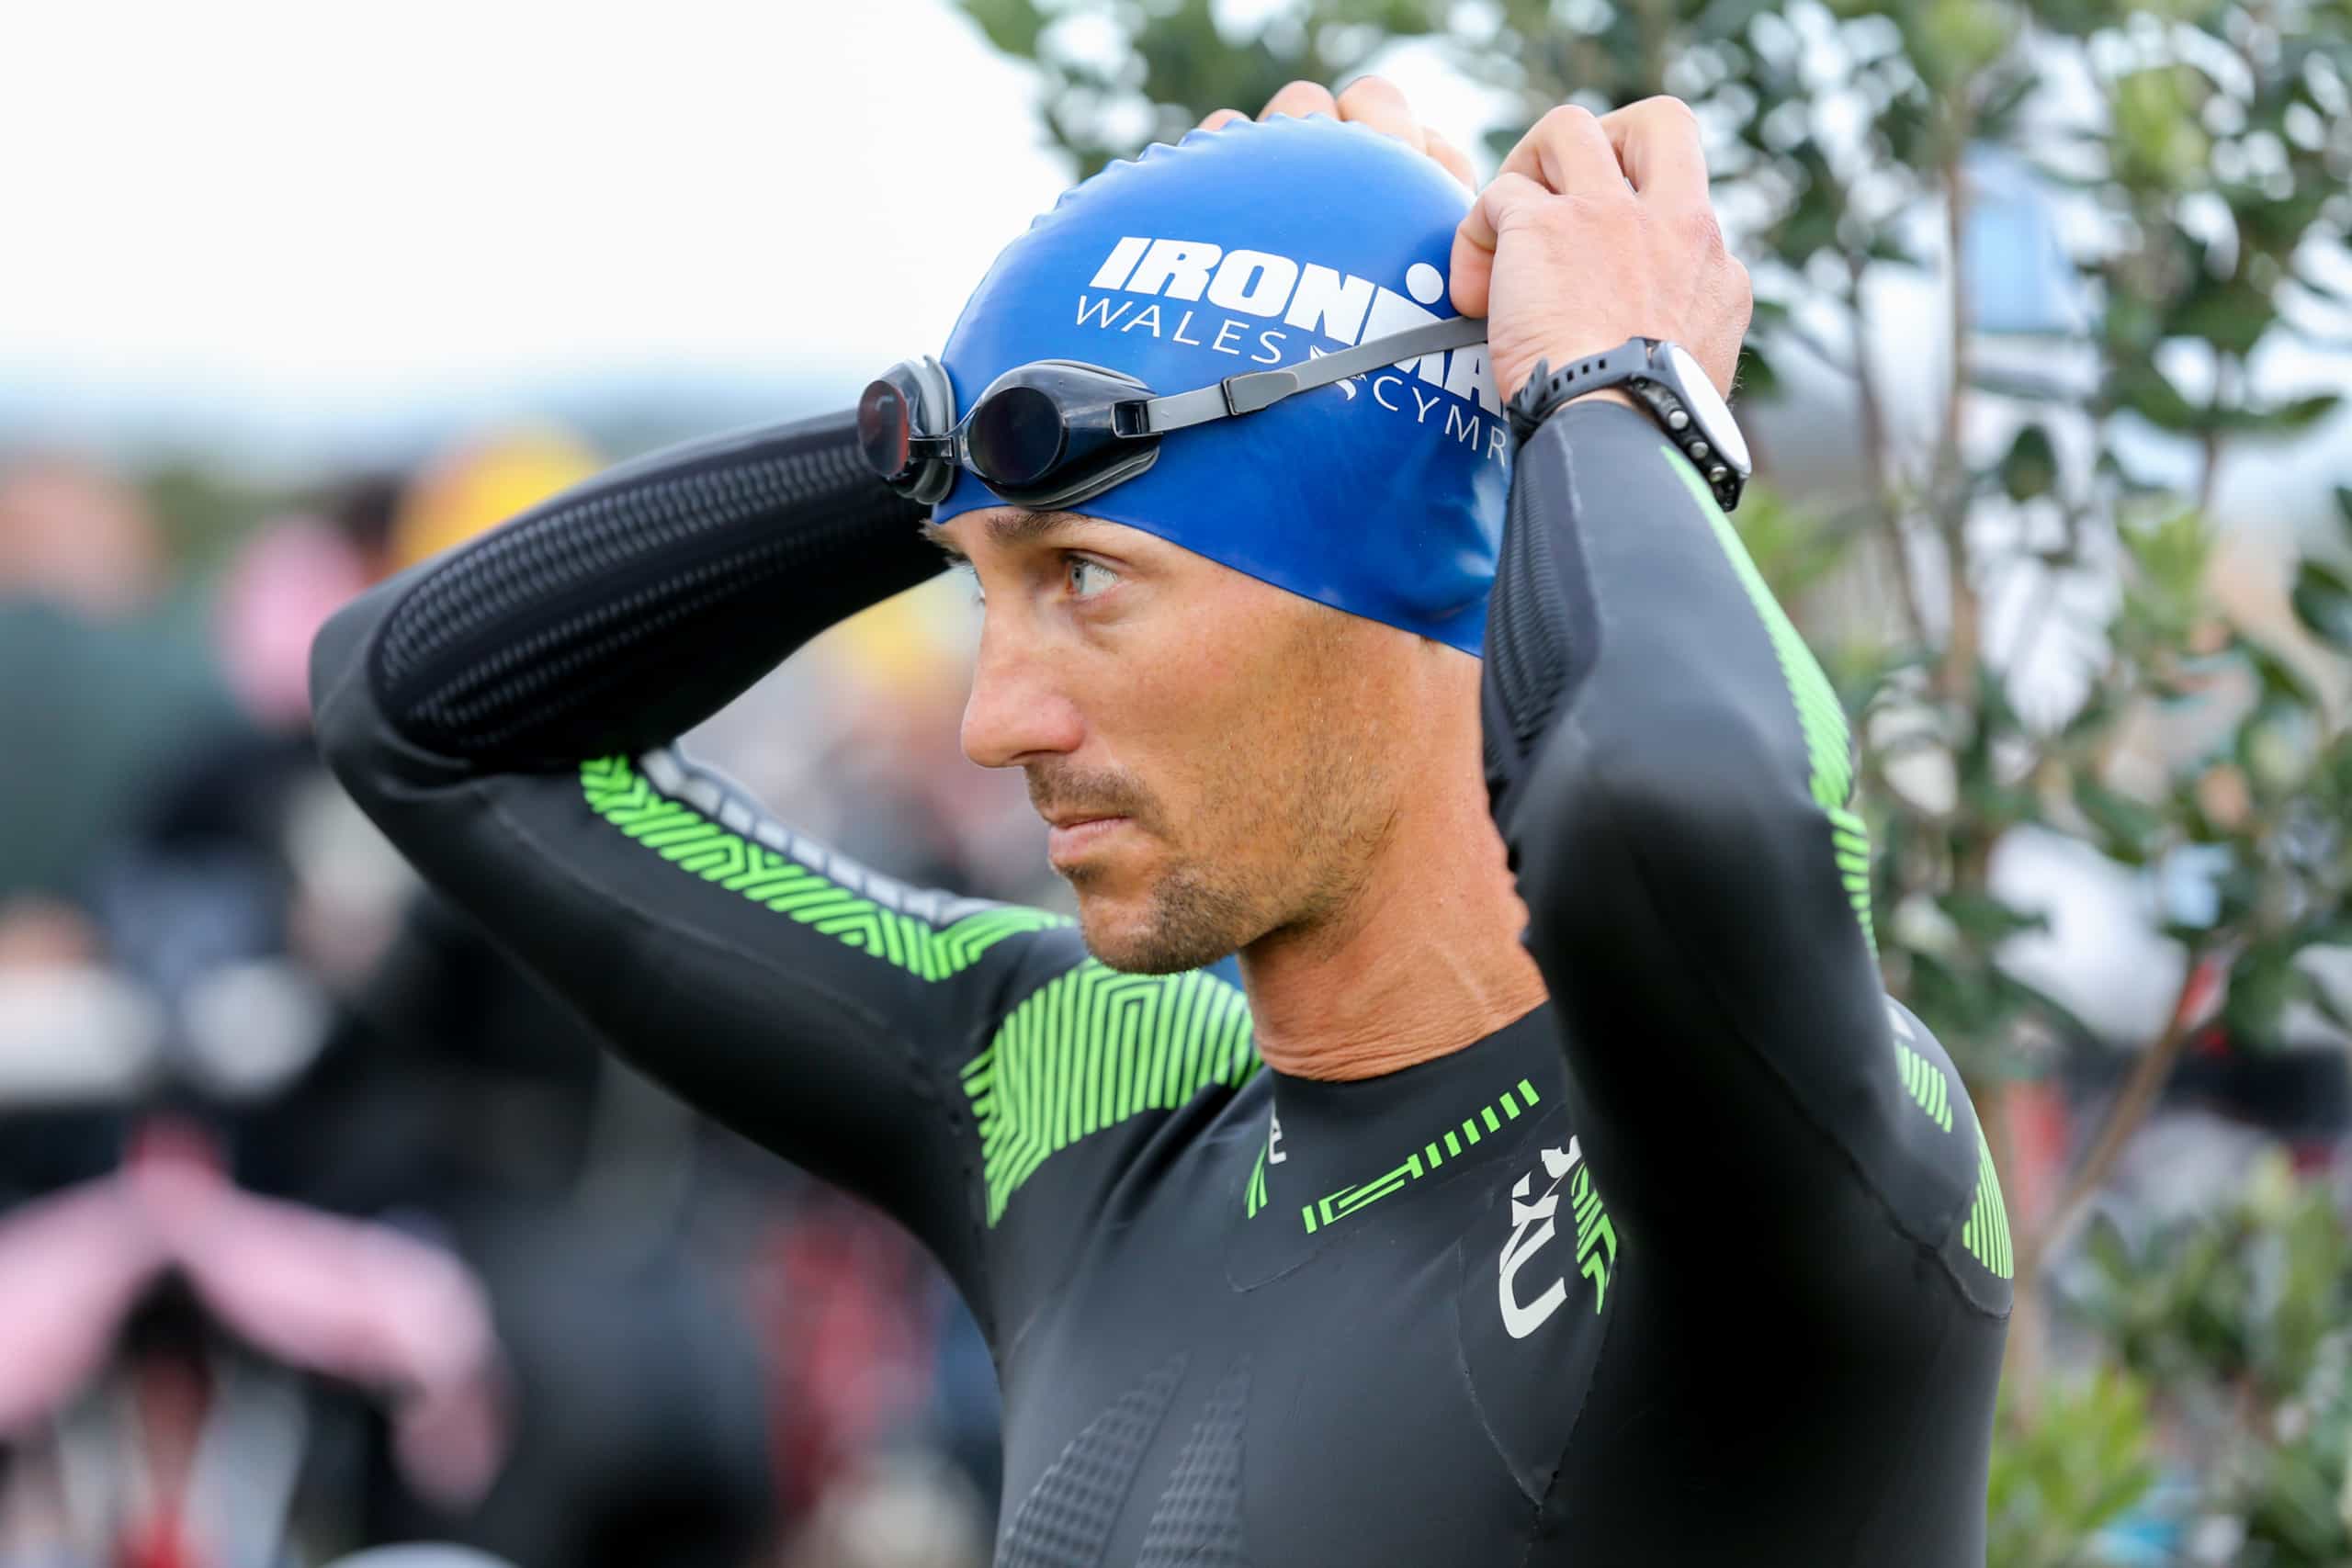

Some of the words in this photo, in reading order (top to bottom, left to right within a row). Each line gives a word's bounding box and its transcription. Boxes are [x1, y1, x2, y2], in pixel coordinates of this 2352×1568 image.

[1076, 295, 1286, 365] WALES
[1373, 375, 1507, 468] CYMR
[1089, 236, 1510, 423] IRONMA
